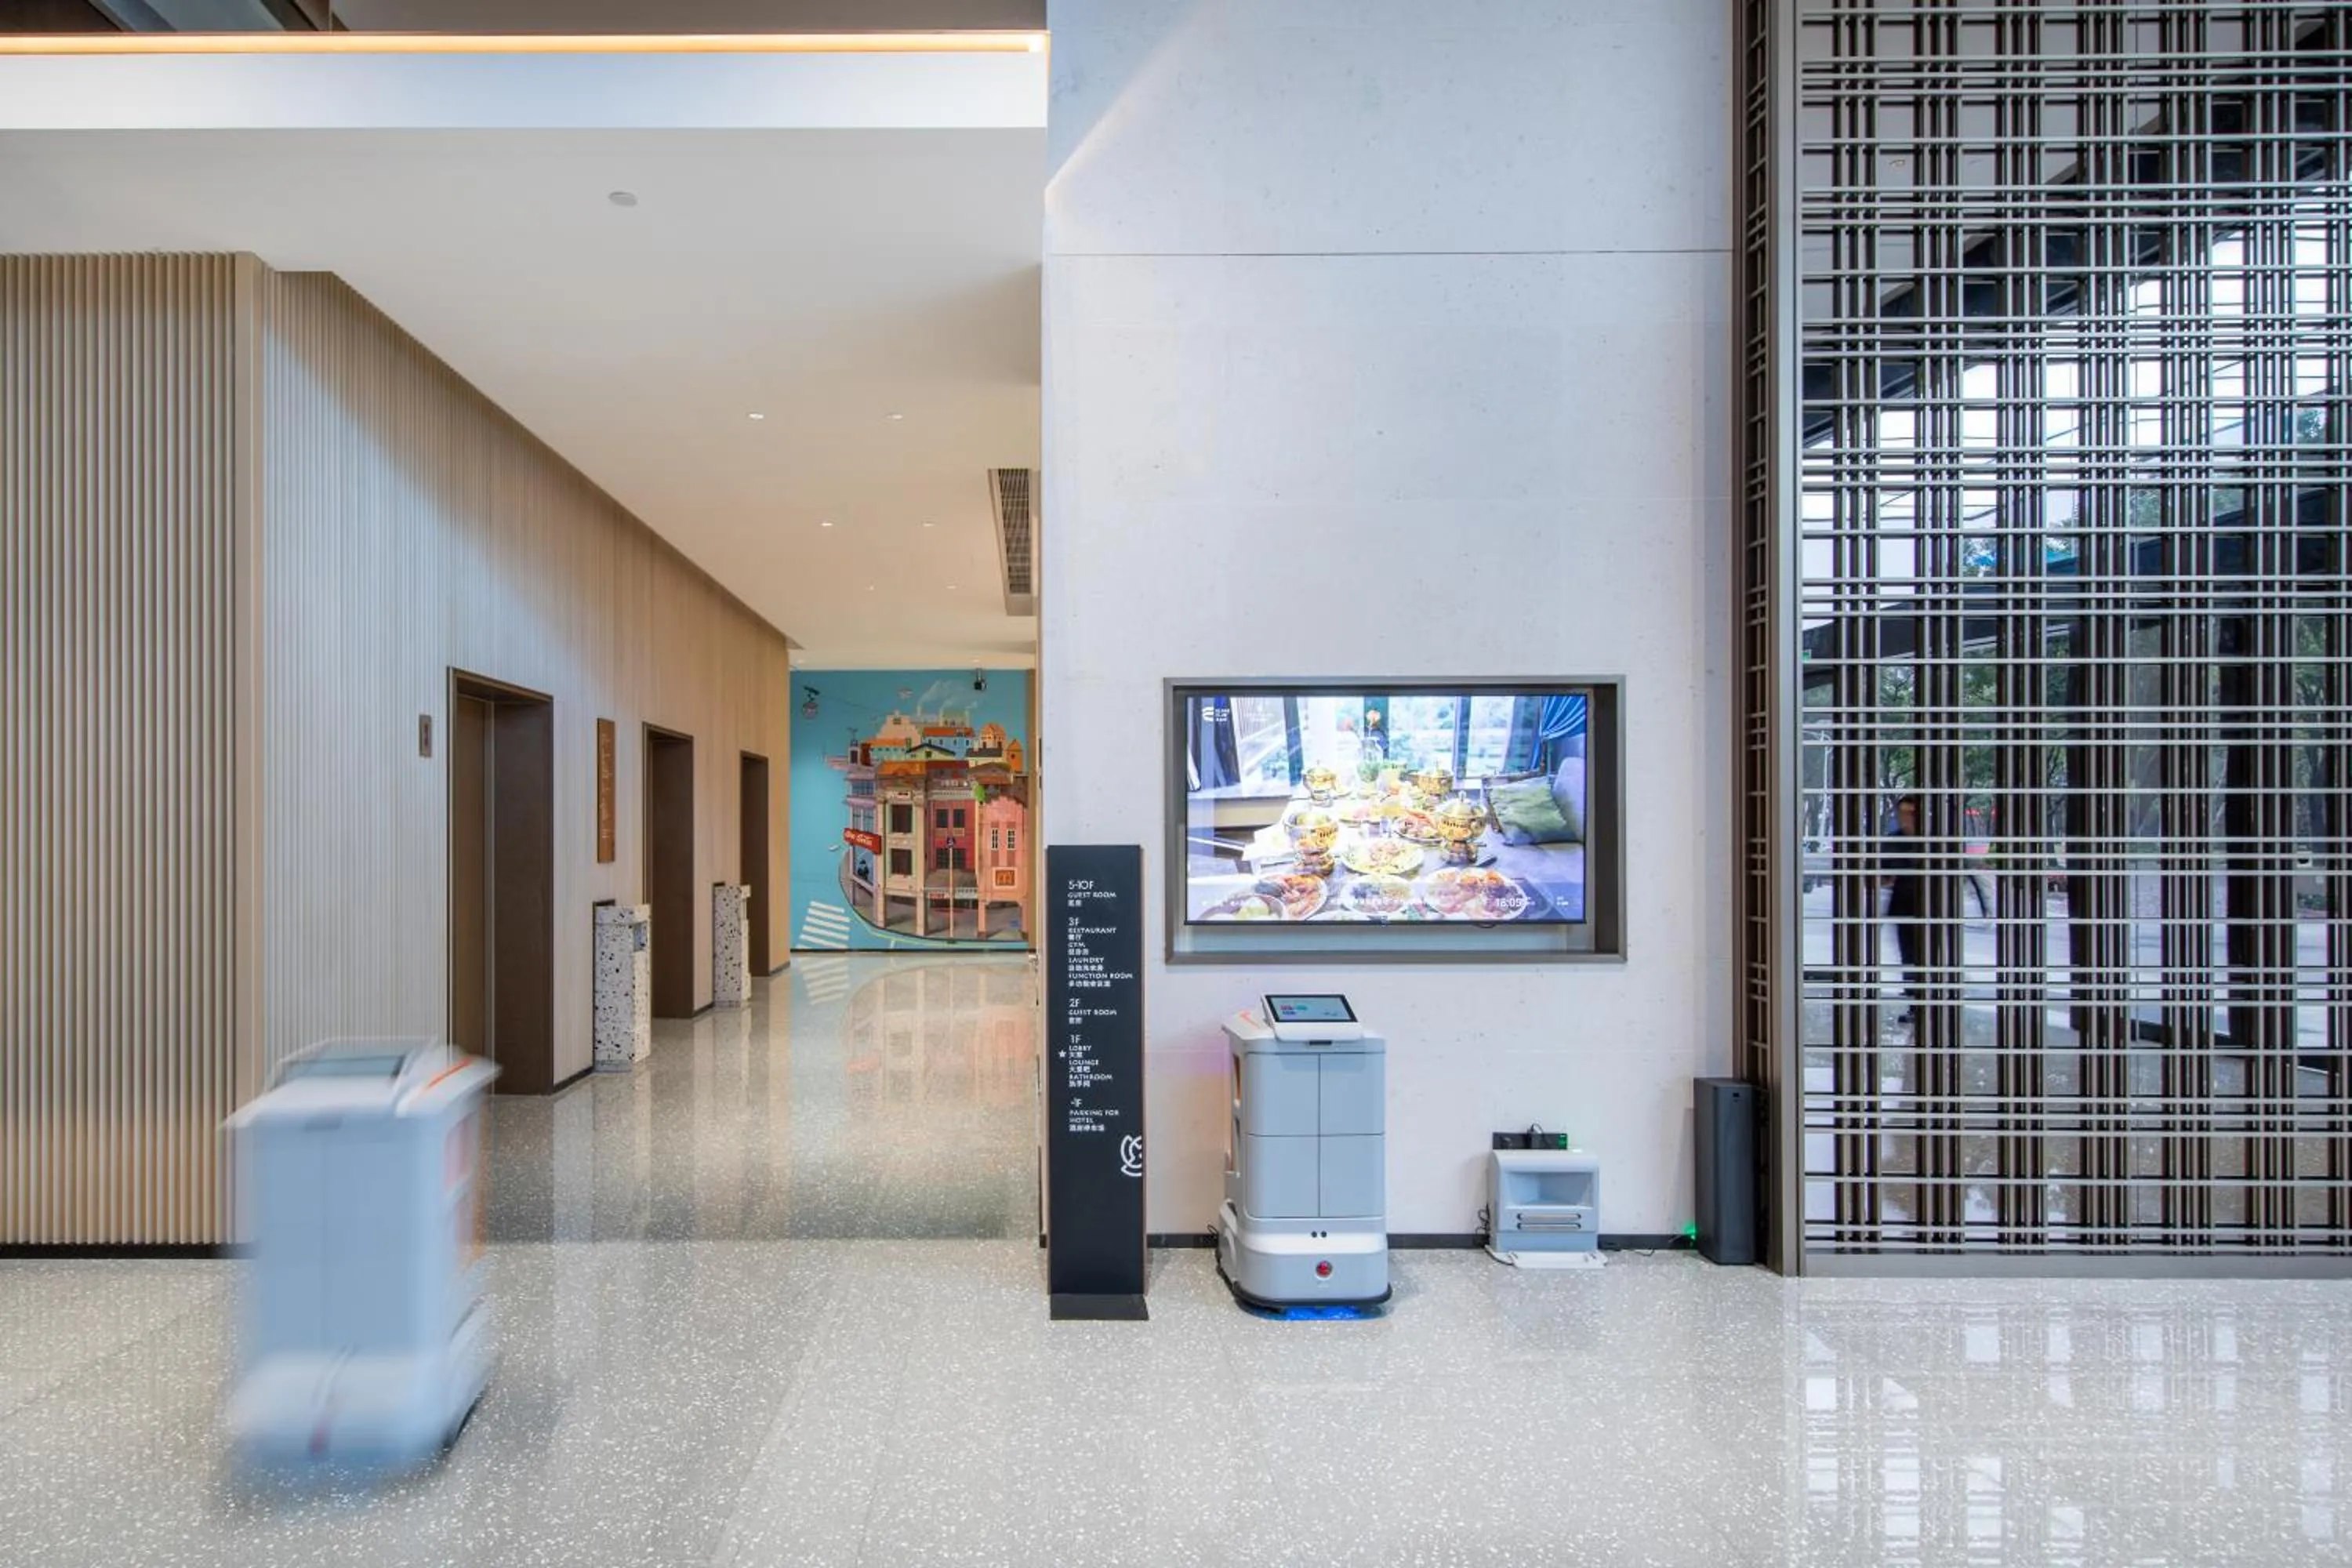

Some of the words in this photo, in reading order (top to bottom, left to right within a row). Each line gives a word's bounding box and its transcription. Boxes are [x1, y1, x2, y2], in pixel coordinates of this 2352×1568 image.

[1069, 916, 1080, 926] 3F
[1069, 998, 1080, 1007] 2F
[1070, 1034, 1081, 1044] 1F
